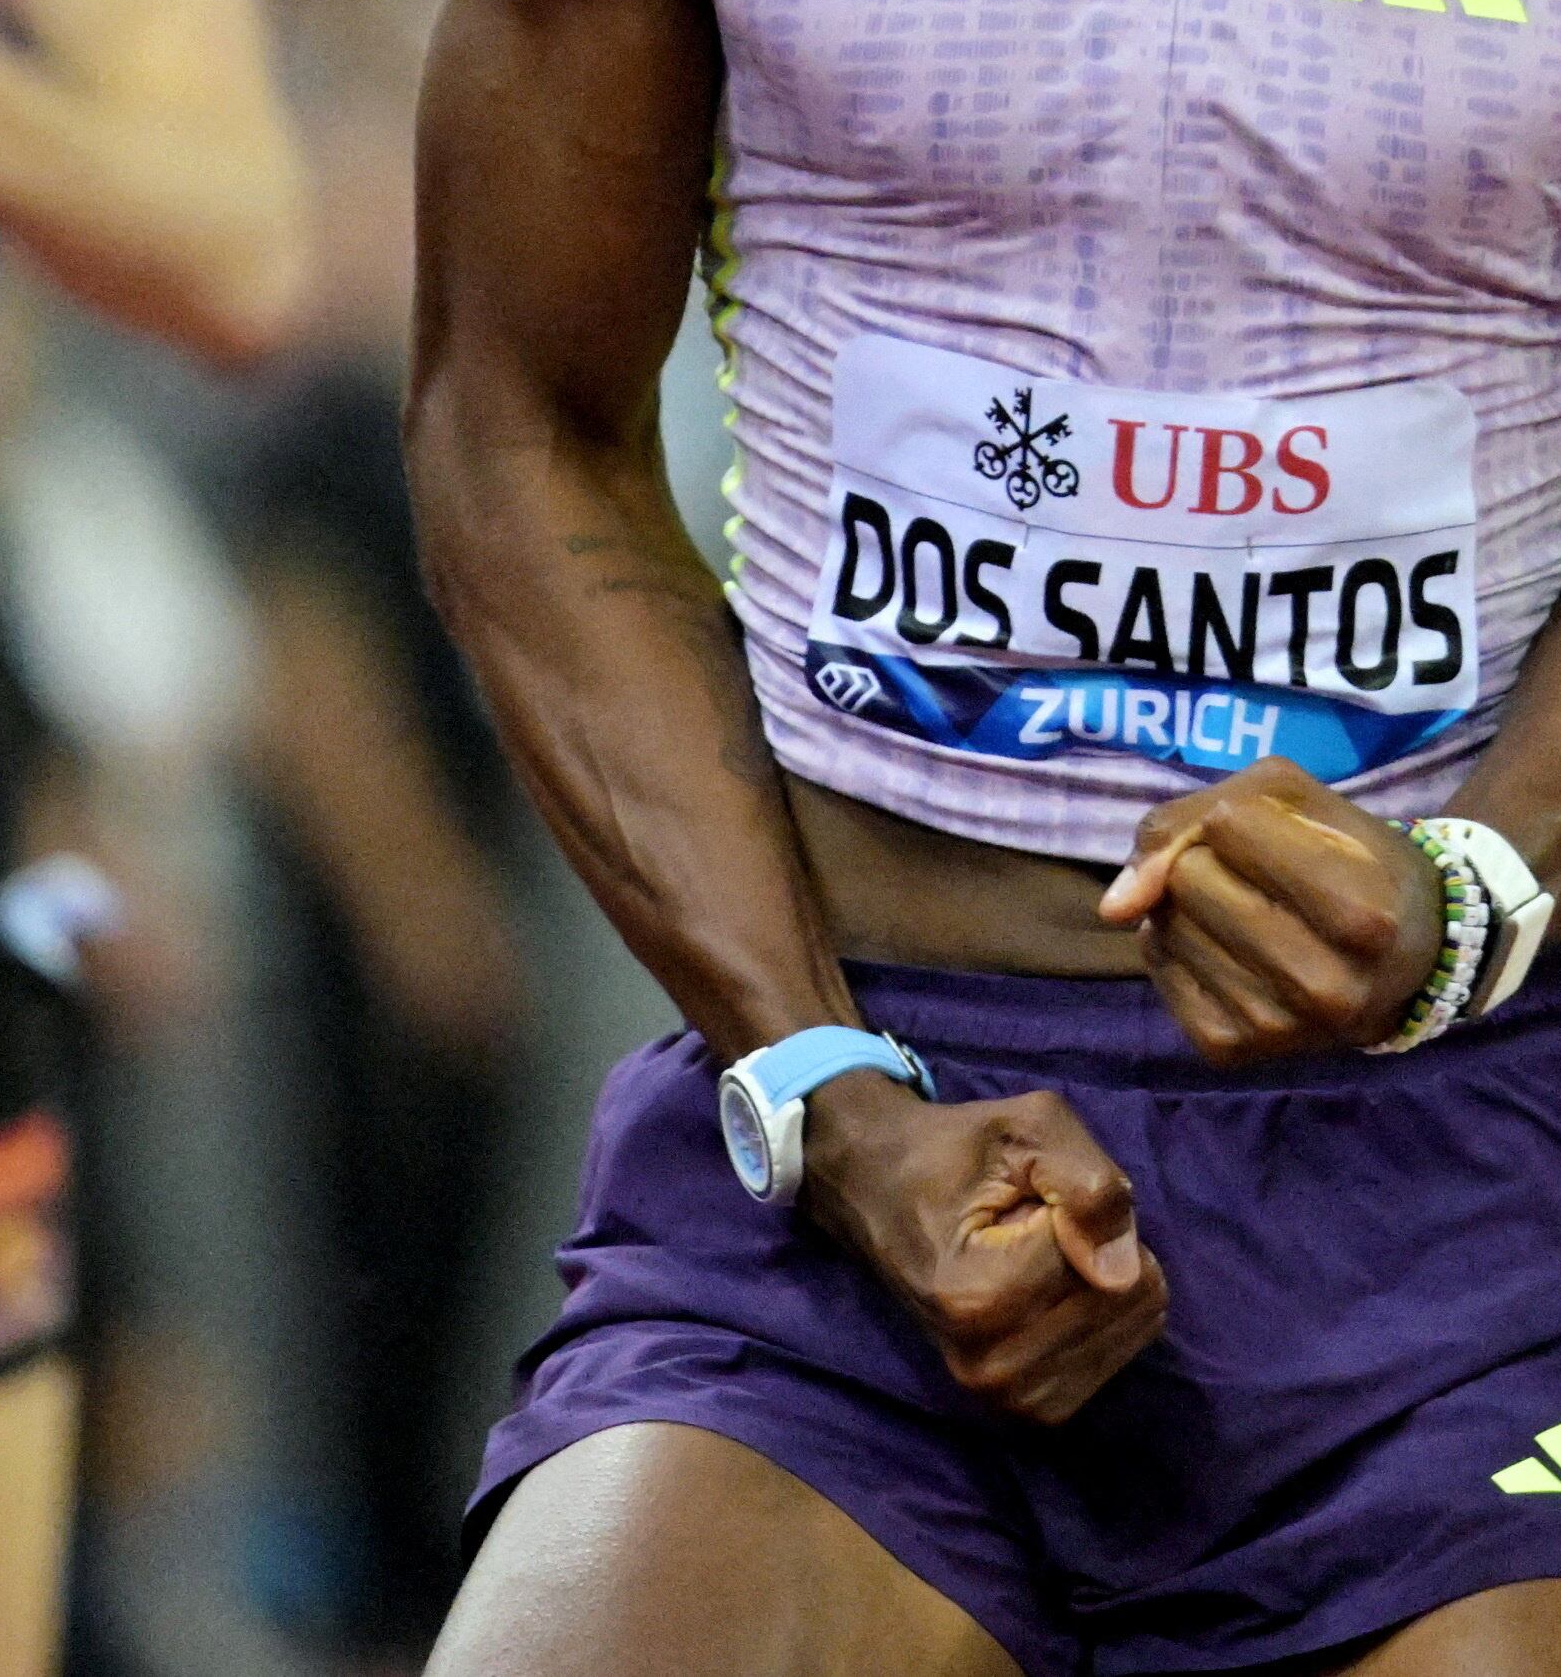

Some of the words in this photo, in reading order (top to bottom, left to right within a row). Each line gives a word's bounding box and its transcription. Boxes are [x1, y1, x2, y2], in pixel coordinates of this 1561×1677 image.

[1107, 417, 1331, 516] UBS
[832, 490, 1020, 650] DOS
[1043, 549, 1463, 691] SANTOS
[1017, 685, 1280, 759] ZURICH
